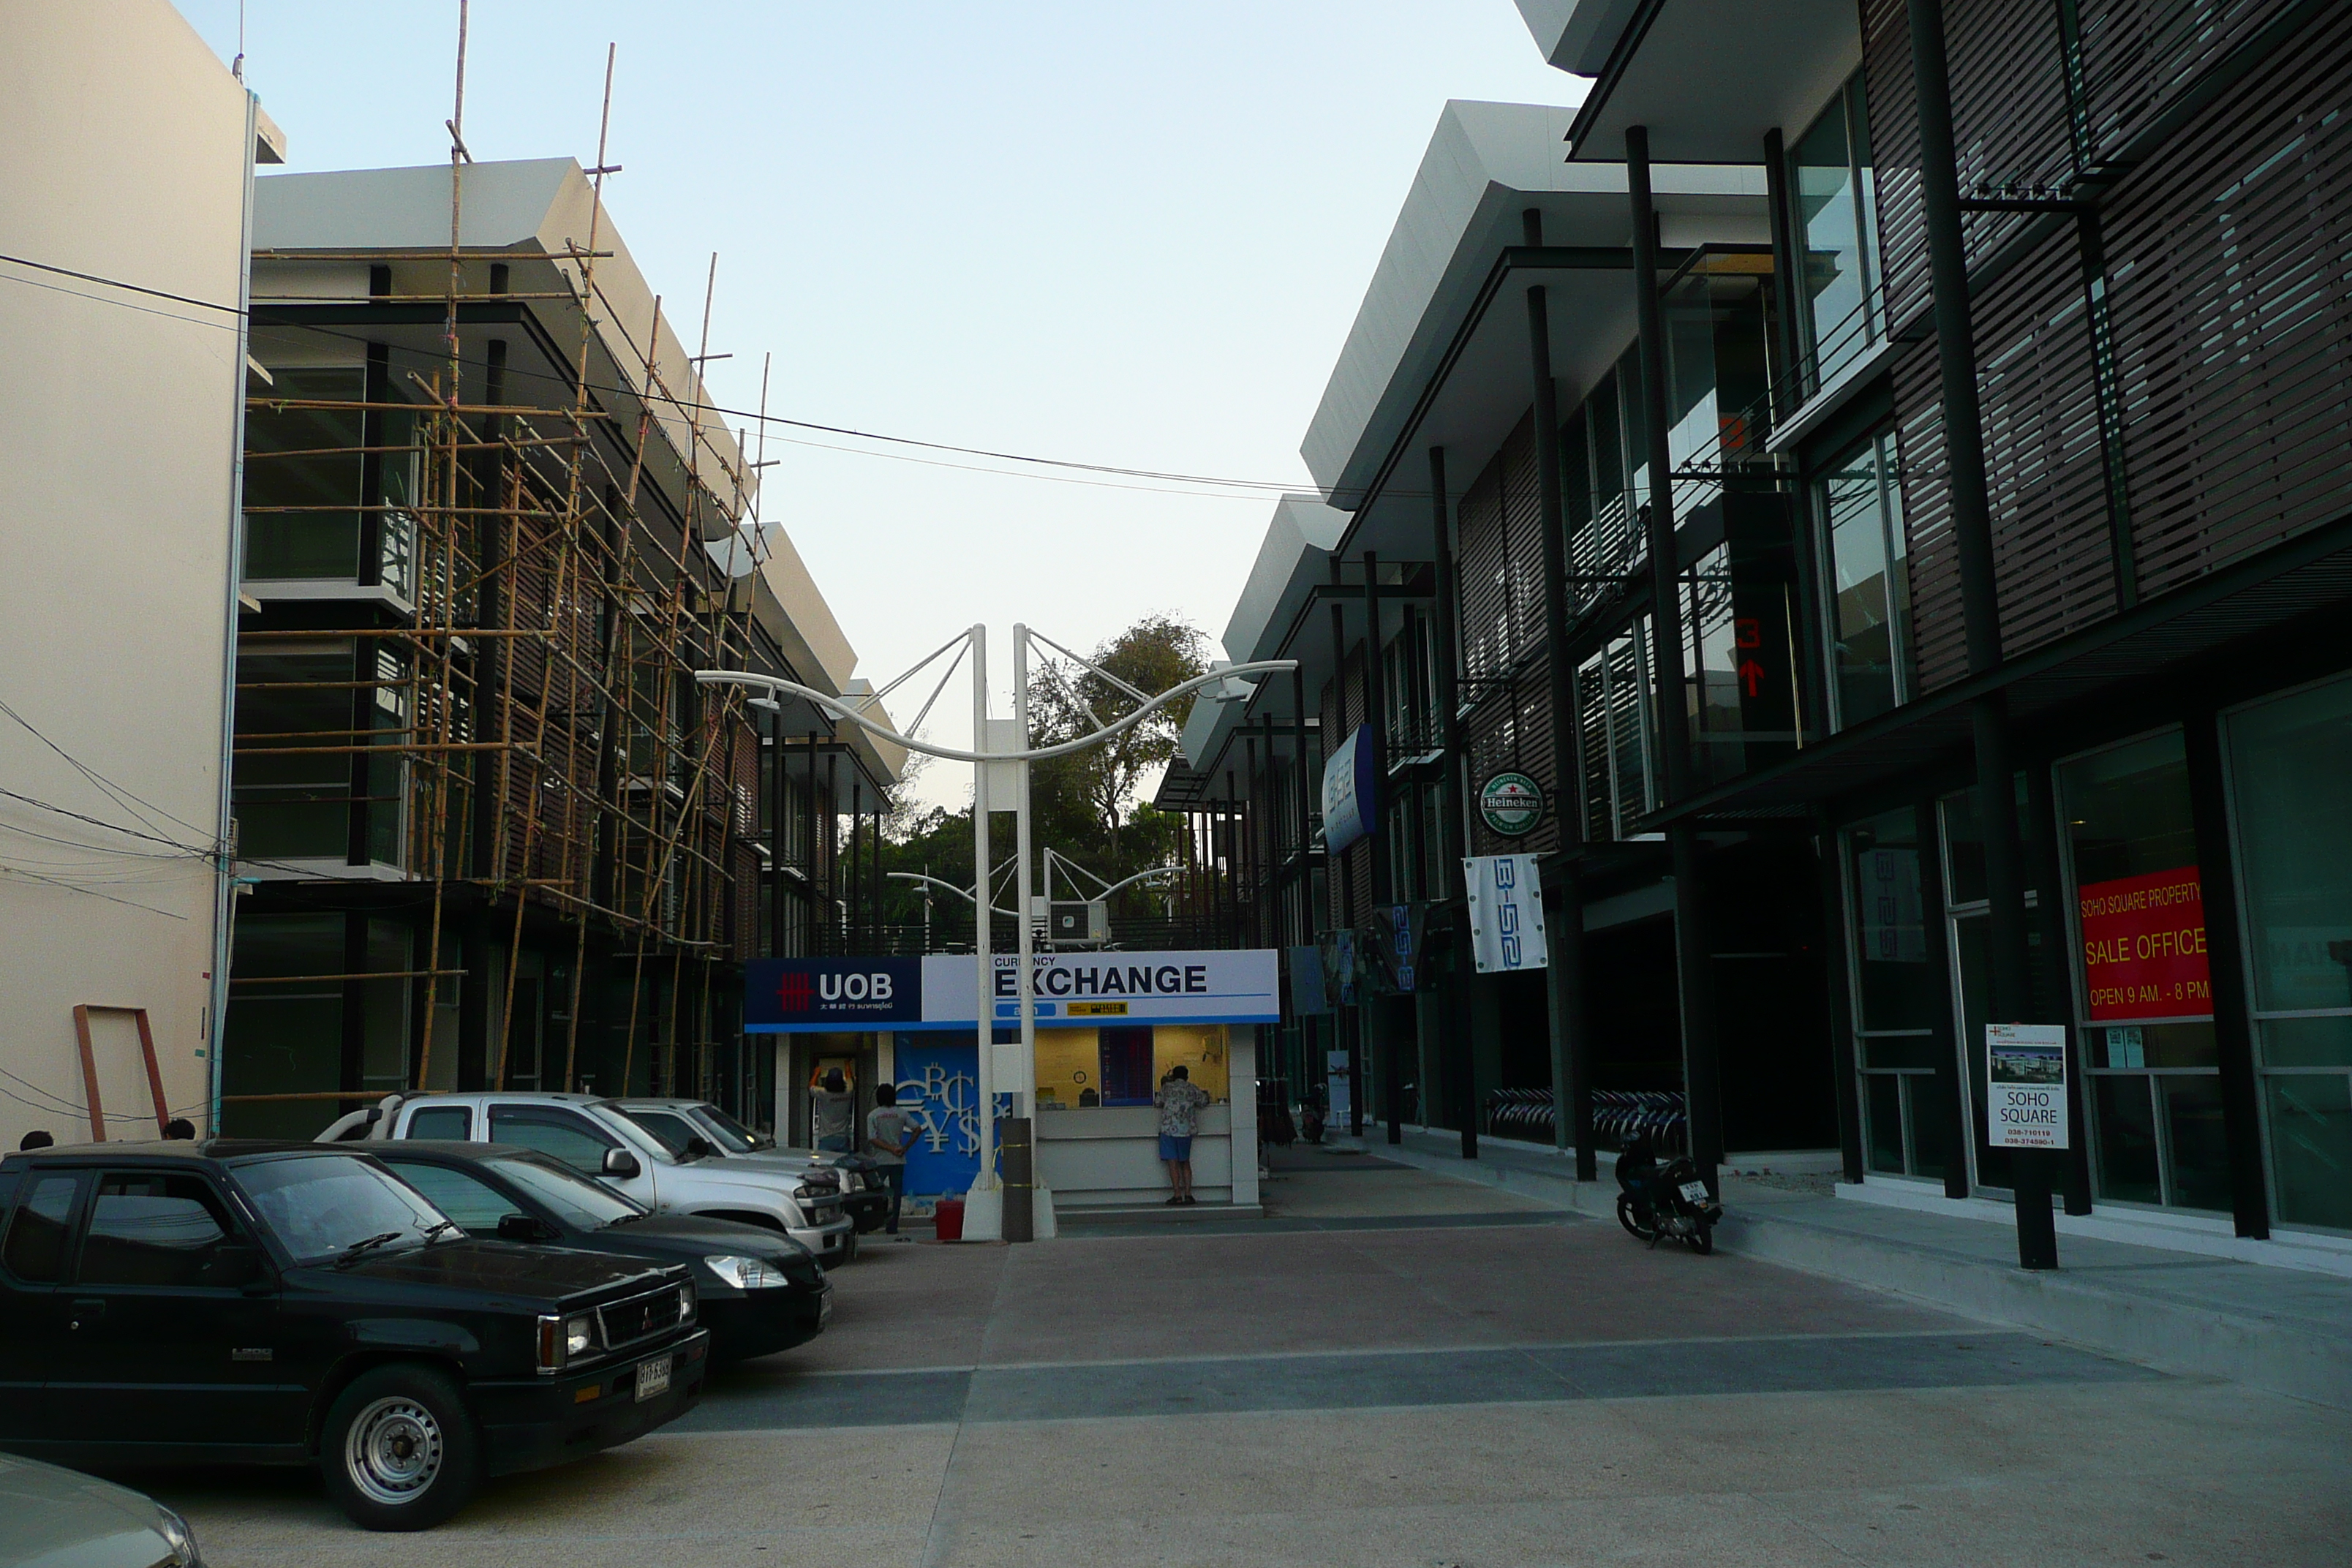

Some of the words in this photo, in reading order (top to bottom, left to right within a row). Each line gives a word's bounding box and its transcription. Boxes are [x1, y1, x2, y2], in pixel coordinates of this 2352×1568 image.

[1736, 617, 1761, 649] 3
[1491, 776, 1518, 789] HEINEKEN
[1487, 797, 1538, 807] Heineken
[2081, 897, 2106, 918] SOHO
[2108, 891, 2147, 913] SQUARE
[2149, 882, 2201, 908] PROPERTY
[1494, 859, 1522, 968] B-52
[2085, 937, 2131, 965] SALE
[2136, 927, 2207, 960] OFFICE
[995, 957, 1056, 967] CURNCY
[819, 973, 893, 1000] UOB
[995, 965, 1207, 996] EXCHANGE
[2089, 987, 2125, 1006] OPEN
[2127, 986, 2136, 1003] 9
[2139, 984, 2163, 1003] AM.
[2174, 982, 2183, 1000] 8
[2008, 1092, 2049, 1107] SOHO
[2000, 1108, 2057, 1123] SQUARE
